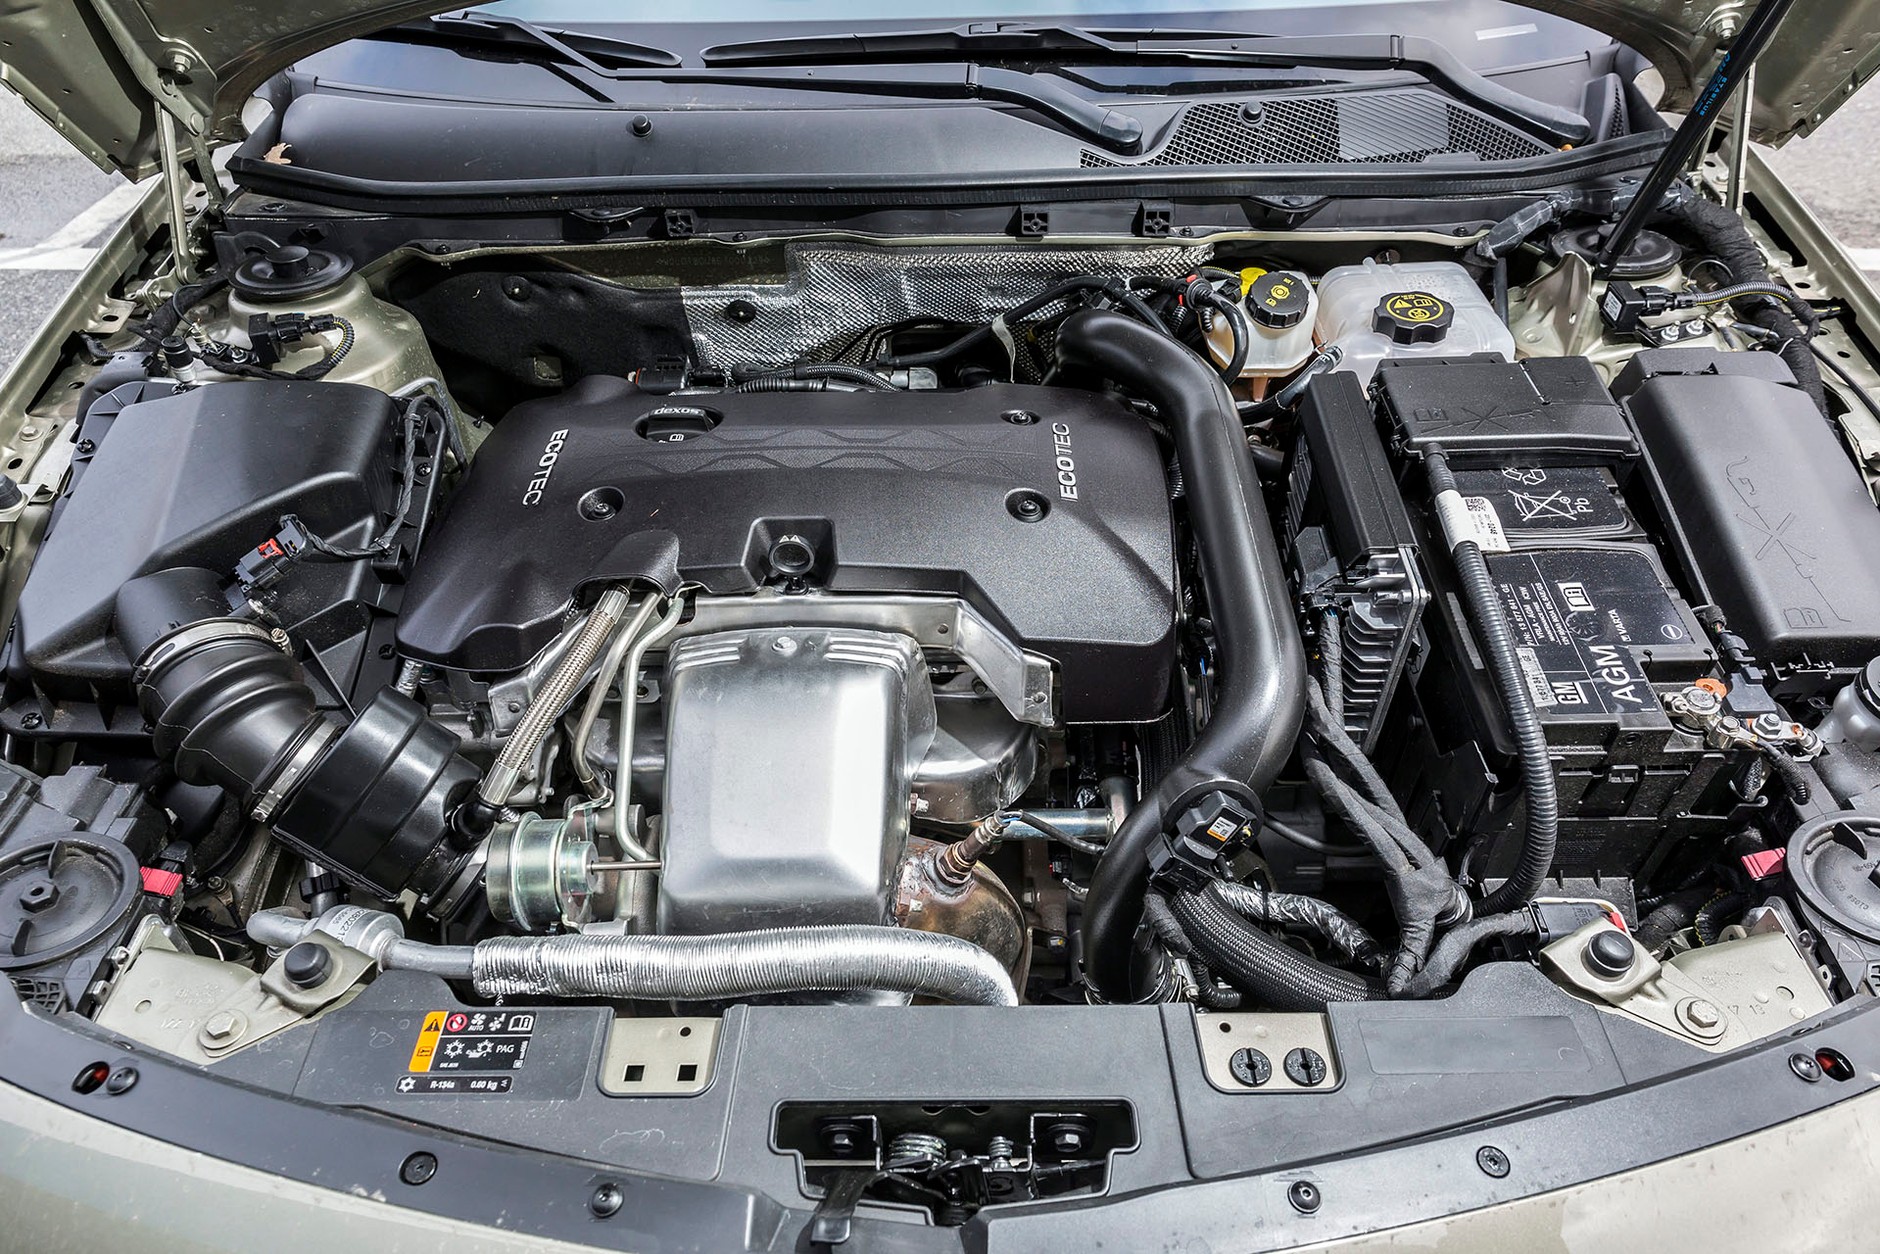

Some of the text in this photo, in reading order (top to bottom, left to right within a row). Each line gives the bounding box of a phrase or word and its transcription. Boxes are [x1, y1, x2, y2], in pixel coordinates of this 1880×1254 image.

[654, 407, 702, 415] dexos
[522, 428, 569, 506] ECOTEC
[1052, 422, 1078, 501] ECOTEC
[1574, 497, 1593, 513] Pb
[1608, 608, 1627, 635] VARTA
[1588, 645, 1643, 704] AGM
[1551, 682, 1582, 704] GM
[496, 1045, 515, 1053] PAG
[430, 1080, 455, 1090] R-134a
[486, 1080, 498, 1091] kg
